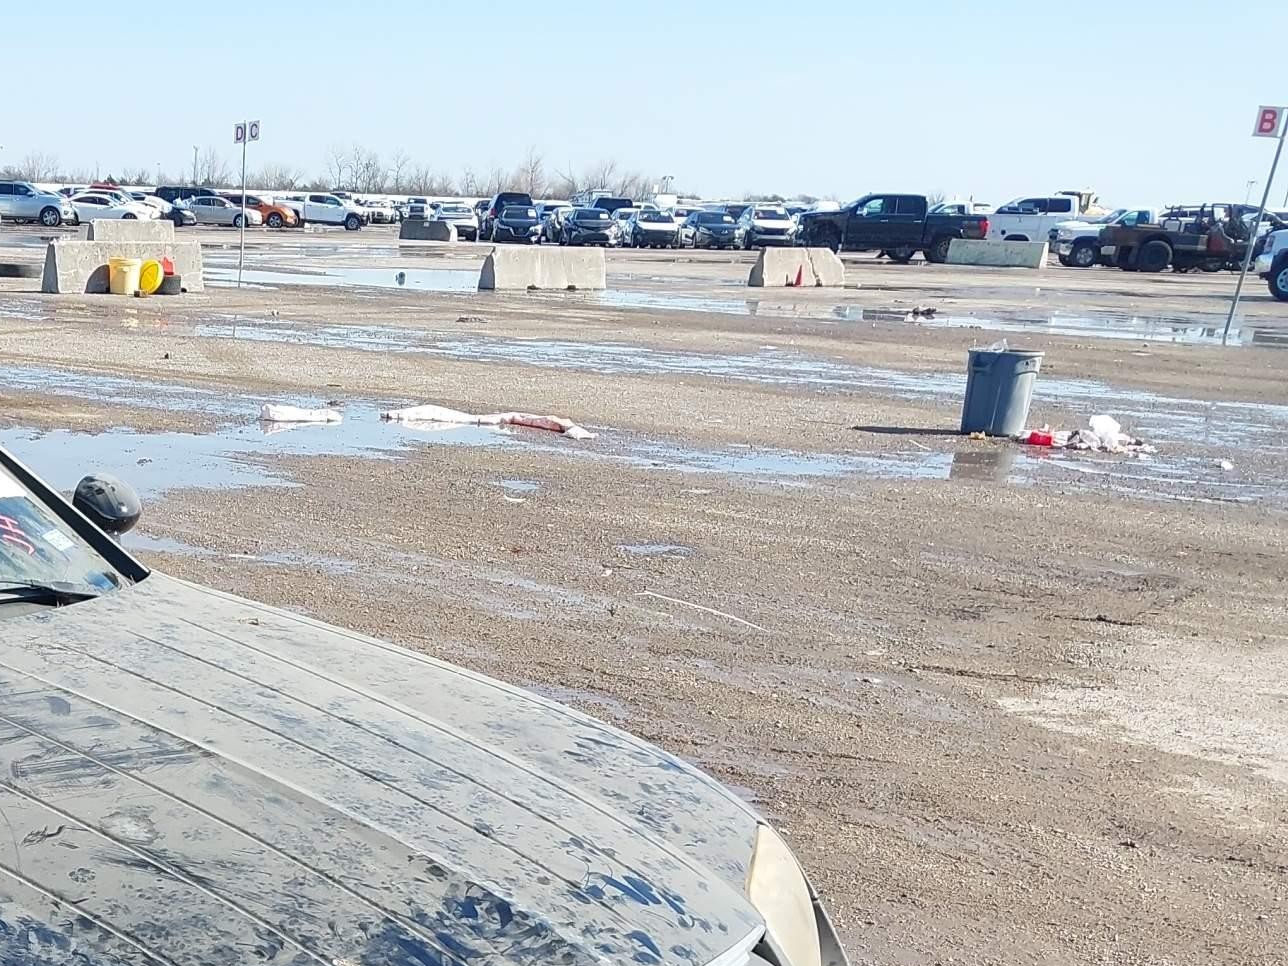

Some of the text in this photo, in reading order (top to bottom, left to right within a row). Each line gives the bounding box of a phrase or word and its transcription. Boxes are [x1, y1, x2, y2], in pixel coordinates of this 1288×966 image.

[1257, 109, 1278, 133] B
[235, 126, 244, 141] D
[250, 123, 258, 139] C
